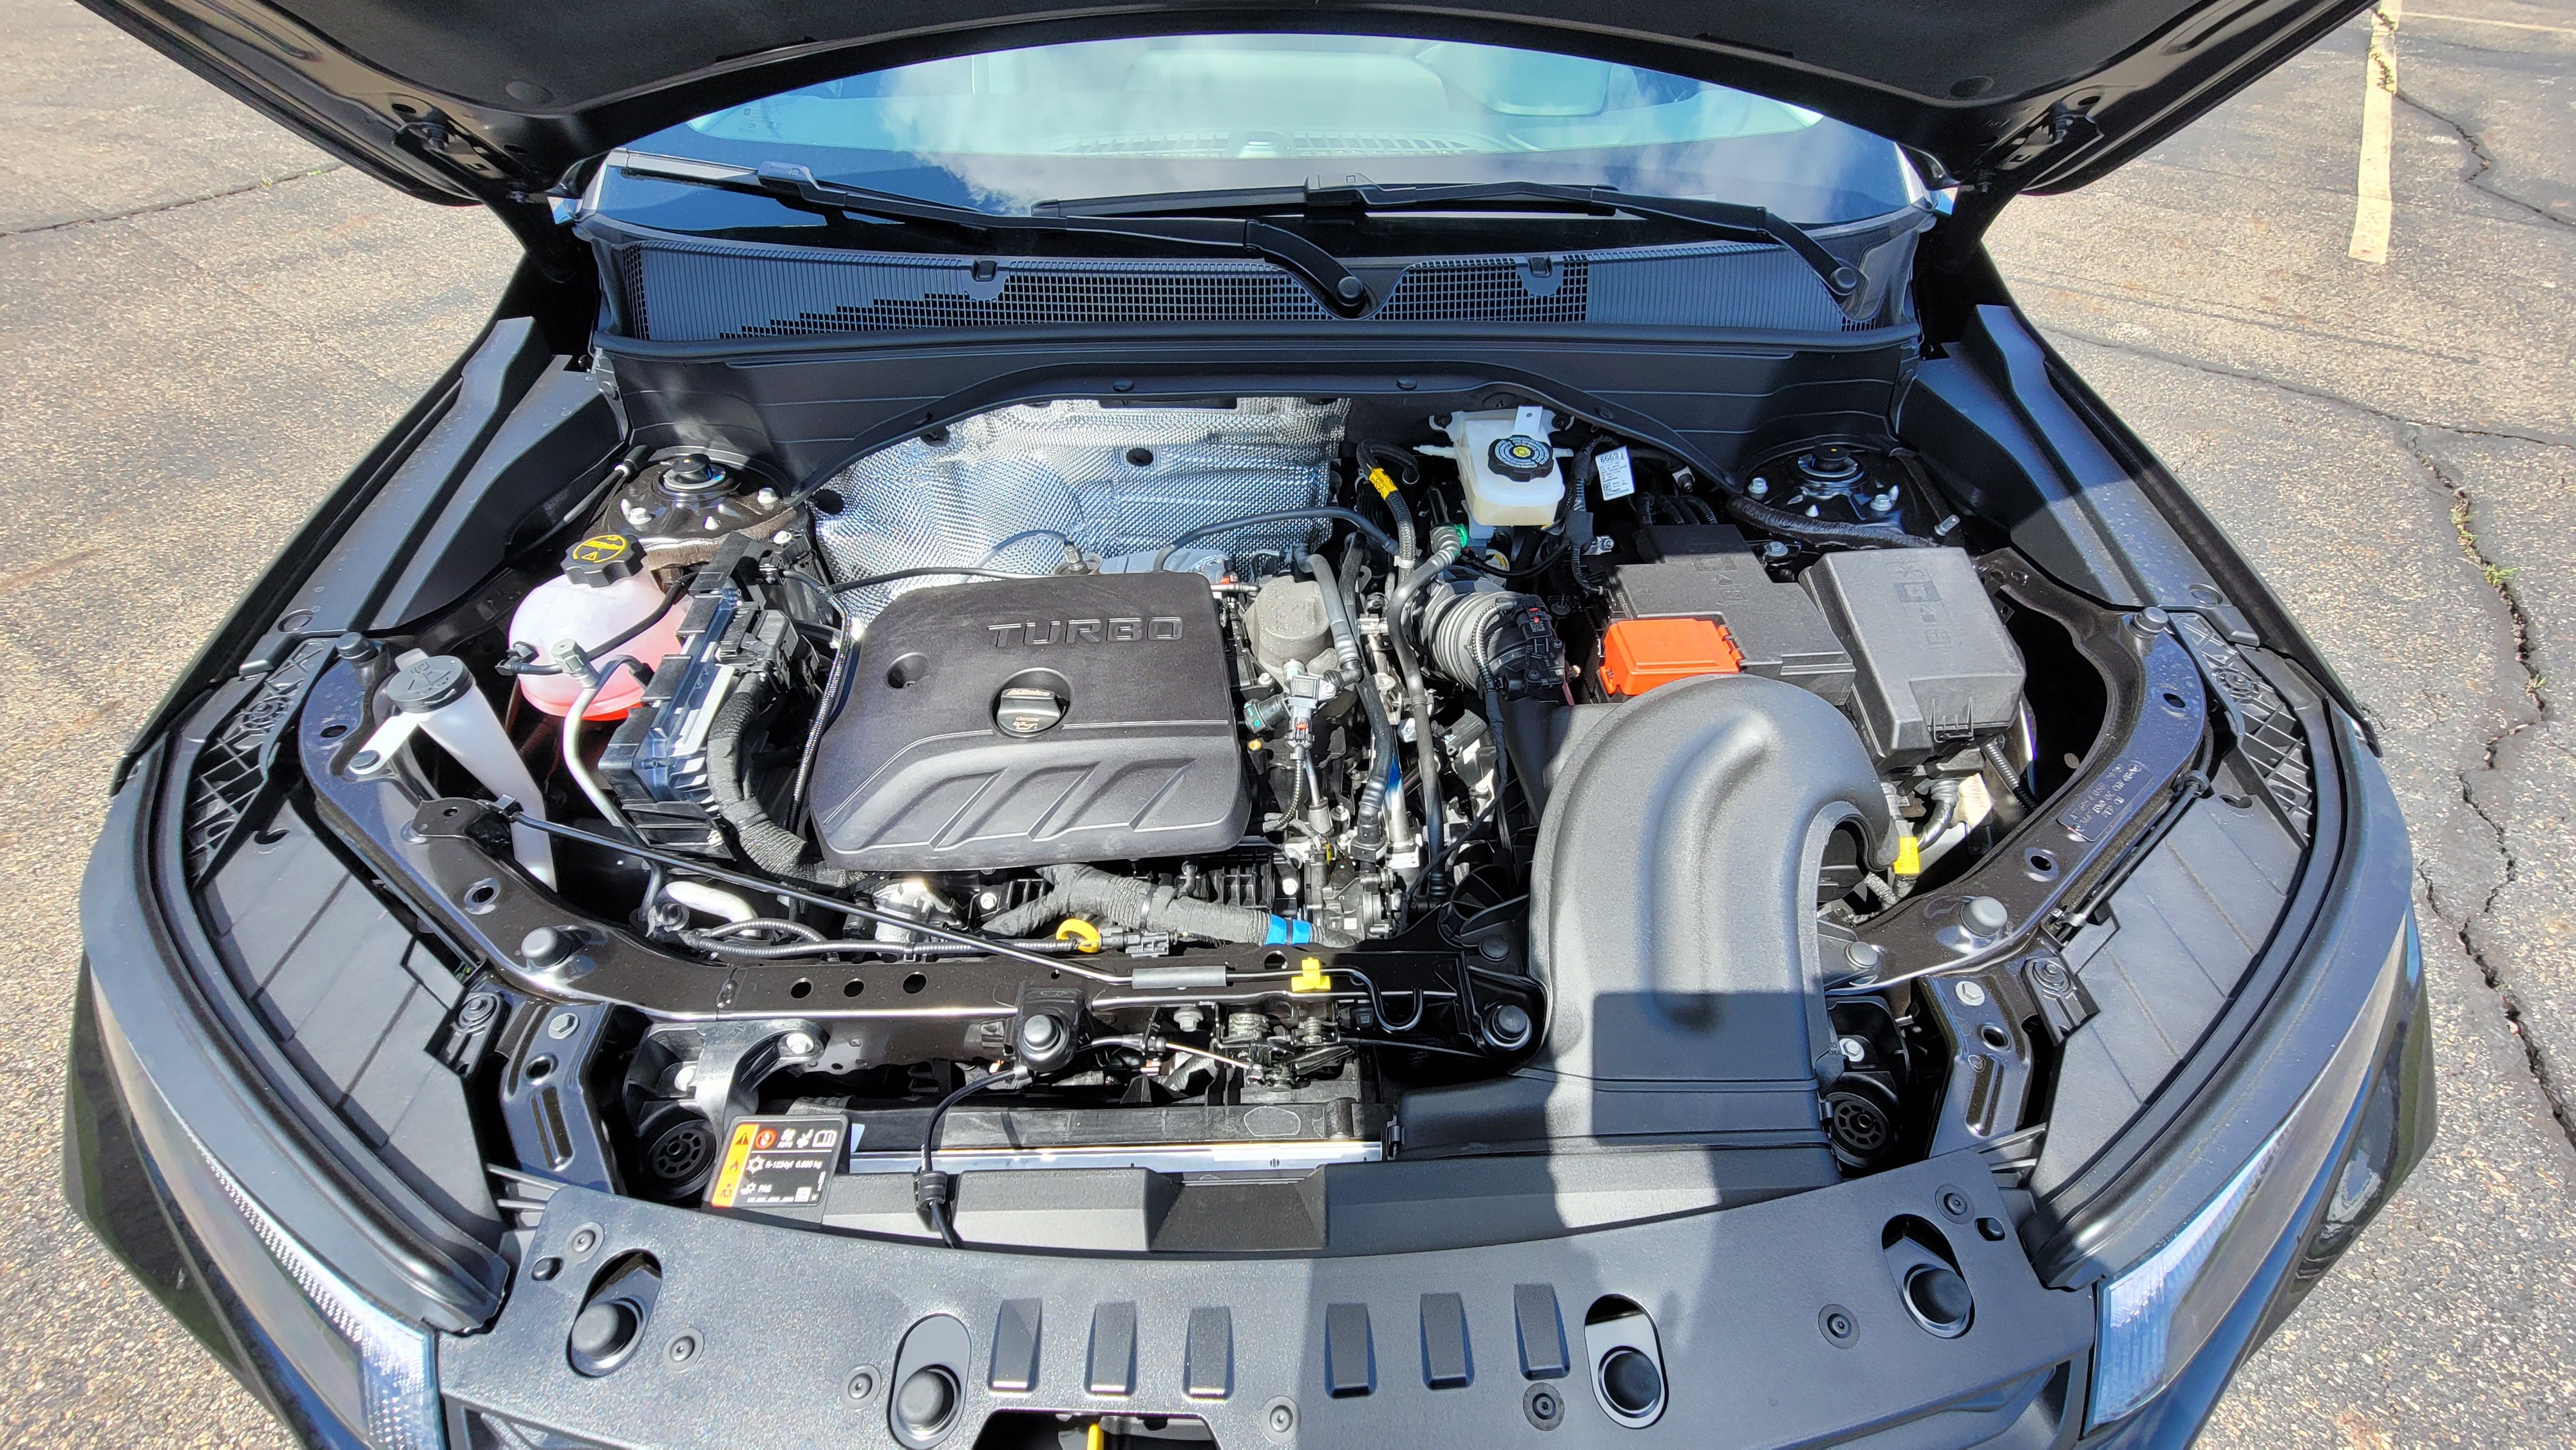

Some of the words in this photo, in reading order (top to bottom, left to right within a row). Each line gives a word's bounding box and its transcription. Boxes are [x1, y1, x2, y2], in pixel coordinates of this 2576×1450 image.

[1600, 452, 1619, 463] 6669
[987, 617, 1183, 648] TURBO
[758, 1184, 772, 1193] PAG
